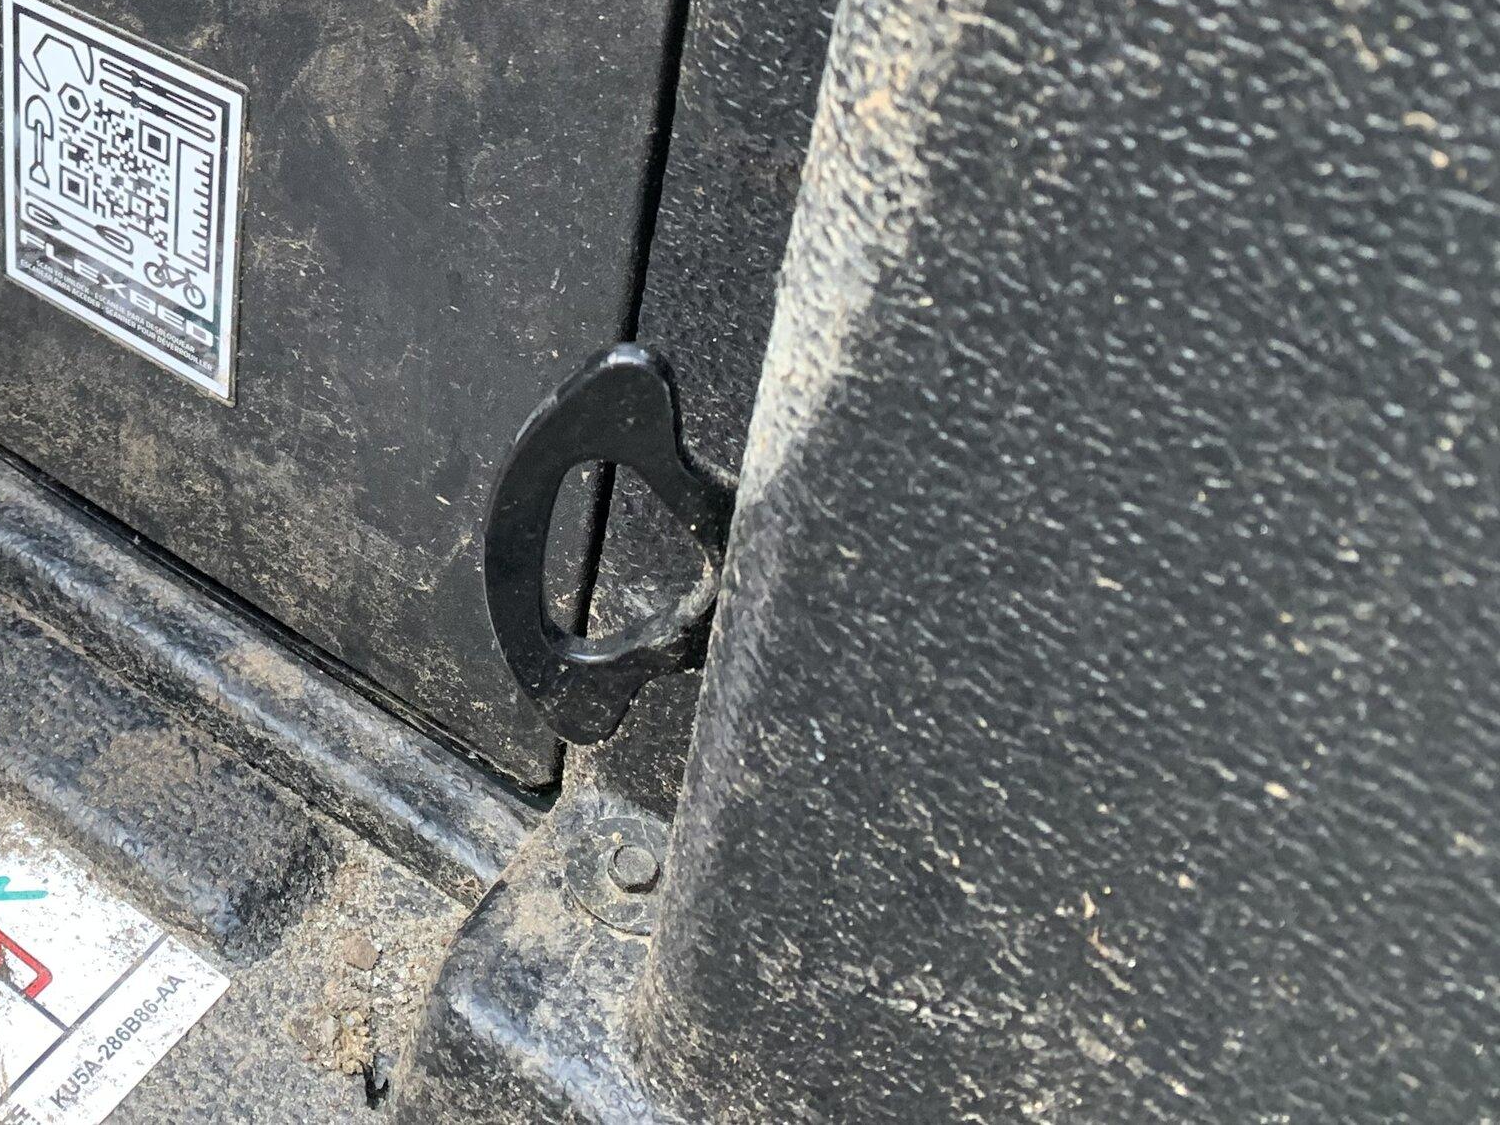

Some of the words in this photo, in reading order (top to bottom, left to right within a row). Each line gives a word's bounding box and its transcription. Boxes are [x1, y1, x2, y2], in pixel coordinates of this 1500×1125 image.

[20, 229, 214, 347] FLEXBED
[54, 277, 71, 292] PARA
[72, 288, 101, 308] ACCEDER
[106, 307, 137, 329] SCANNER
[137, 324, 156, 340] POUR
[64, 274, 90, 294] UNLOCK
[127, 310, 145, 325] PARA
[146, 320, 195, 353] DESBLOQUEAR
[49, 974, 187, 1111] KU5A-286B86-AA
